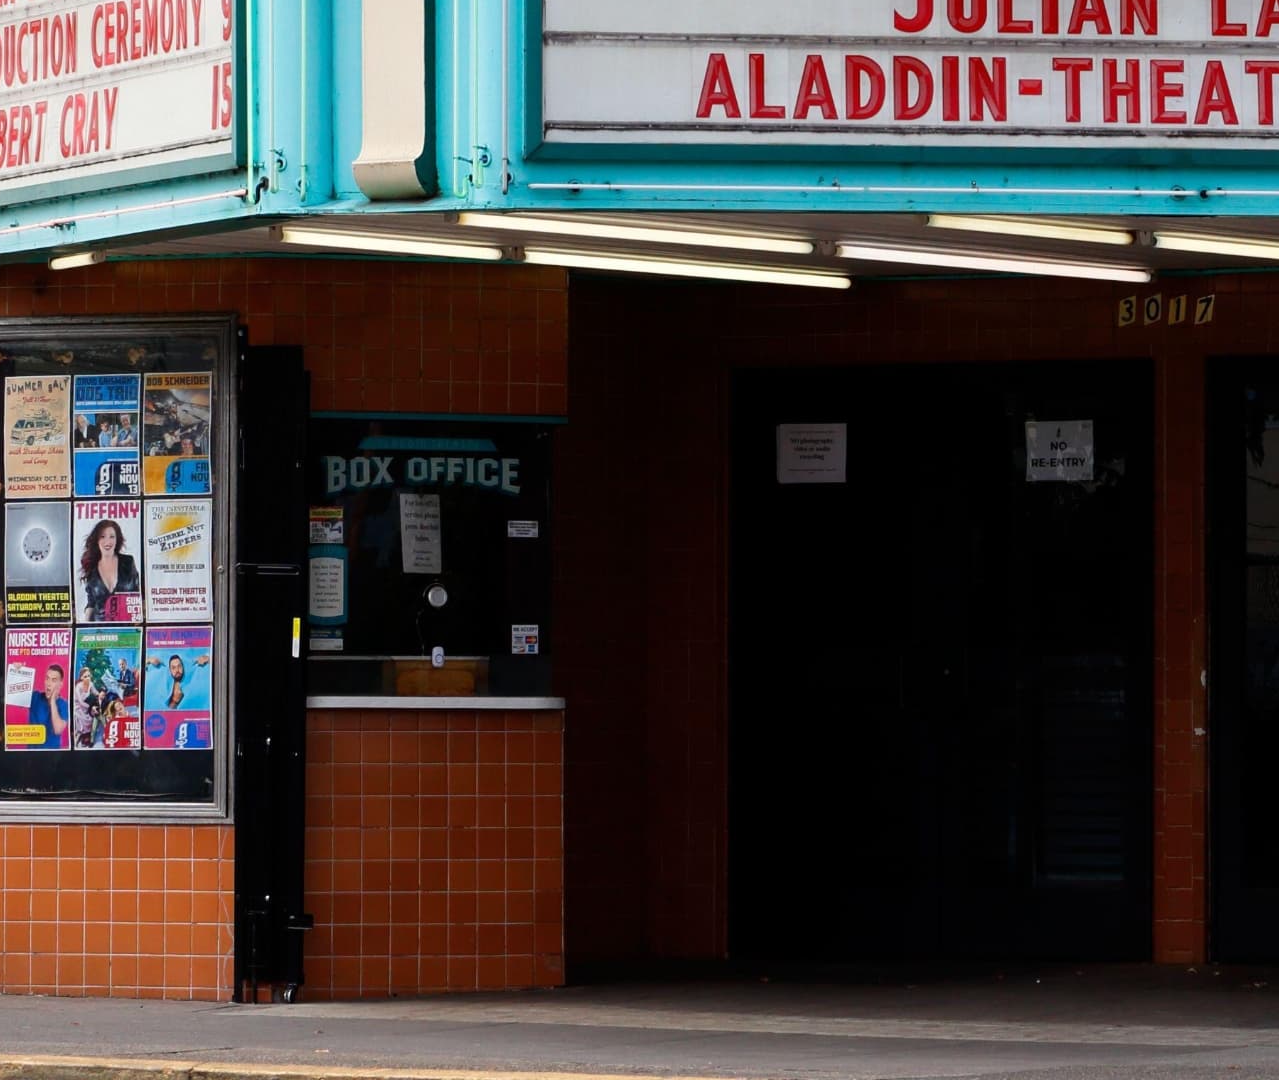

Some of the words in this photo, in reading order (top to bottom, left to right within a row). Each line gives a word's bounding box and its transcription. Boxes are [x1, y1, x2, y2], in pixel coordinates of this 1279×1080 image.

[59, 86, 119, 160] CRAY
[210, 61, 233, 130] 15
[1121, 296, 1213, 323] 3017
[164, 376, 209, 386] SCHNEIDER
[7, 380, 42, 395] SUMMER
[48, 378, 68, 393] SALT
[1049, 441, 1068, 451] NO
[1031, 457, 1086, 467] RE-ENTRY
[121, 463, 138, 473] SAT
[119, 474, 138, 484] NOV
[326, 455, 394, 494] BOX
[407, 457, 521, 495] OFFICE
[8, 483, 37, 491] ALADDIN
[128, 484, 138, 494] 13
[76, 502, 140, 520] TIFFANY
[160, 533, 202, 551] ZIPPERS
[179, 587, 207, 595] THEATER
[8, 593, 36, 601] ALADDIN
[39, 592, 69, 601] THEATER
[126, 596, 141, 605] SUN
[152, 597, 184, 605] THURSDAY
[8, 603, 44, 612] SATURDAY,
[127, 605, 141, 614] OCT
[8, 633, 37, 647] NURSE
[39, 632, 69, 647] BLAKE
[9, 648, 19, 656] THE
[31, 648, 54, 656] COMEDY
[55, 647, 68, 655] TOUR
[125, 721, 140, 730] TUE
[124, 731, 140, 739] NOV
